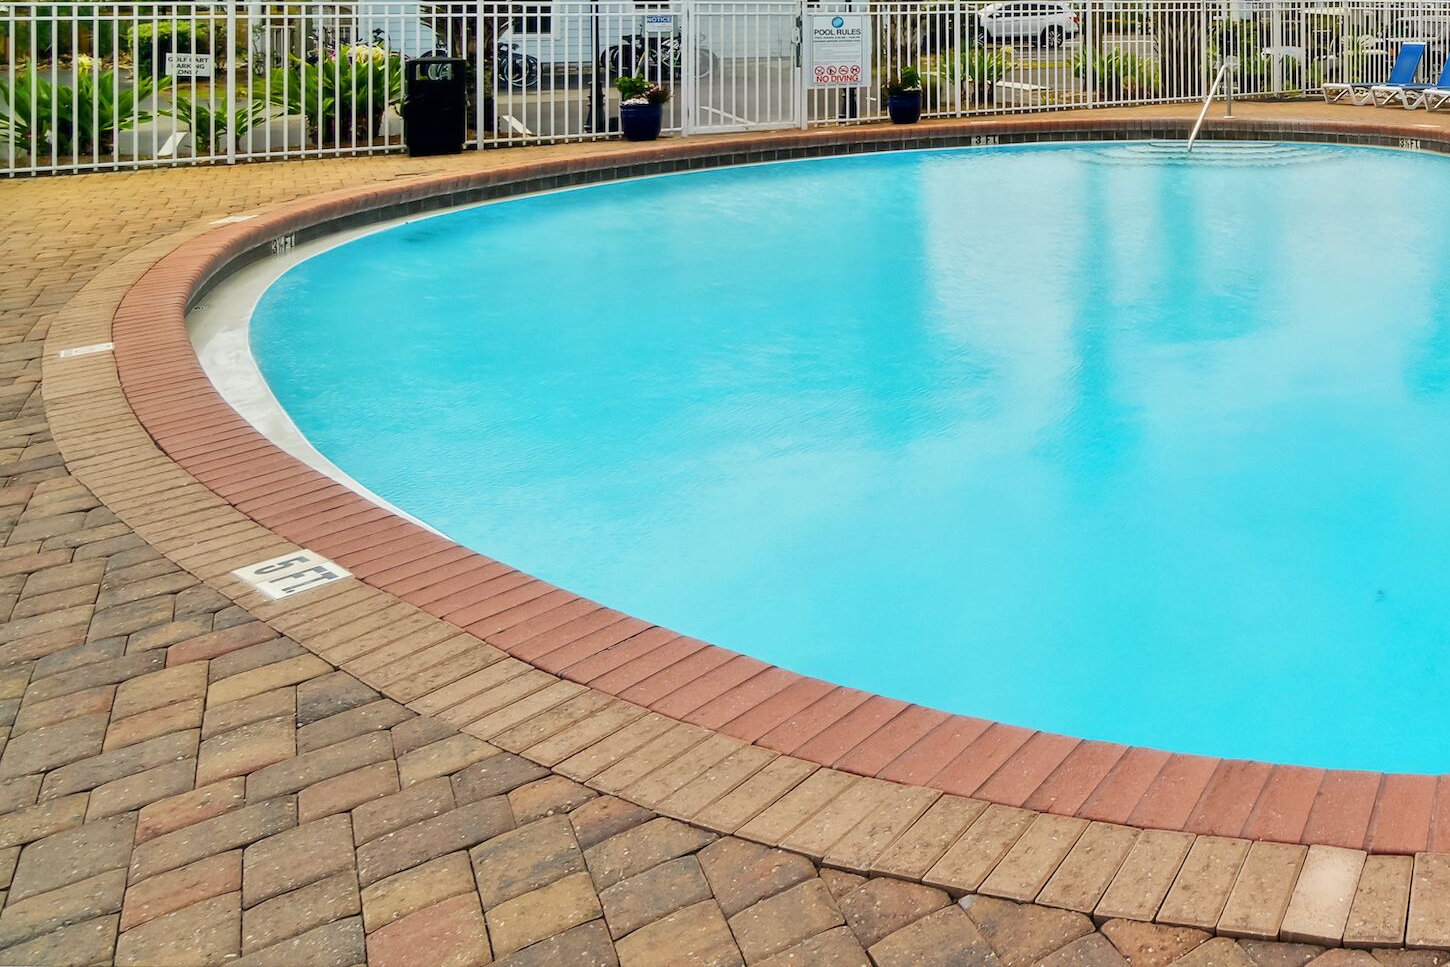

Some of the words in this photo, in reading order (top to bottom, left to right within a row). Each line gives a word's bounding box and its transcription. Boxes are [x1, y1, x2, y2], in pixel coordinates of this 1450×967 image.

[830, 74, 858, 82] DIVING
[253, 555, 312, 575] 5
[268, 565, 339, 593] FT.
